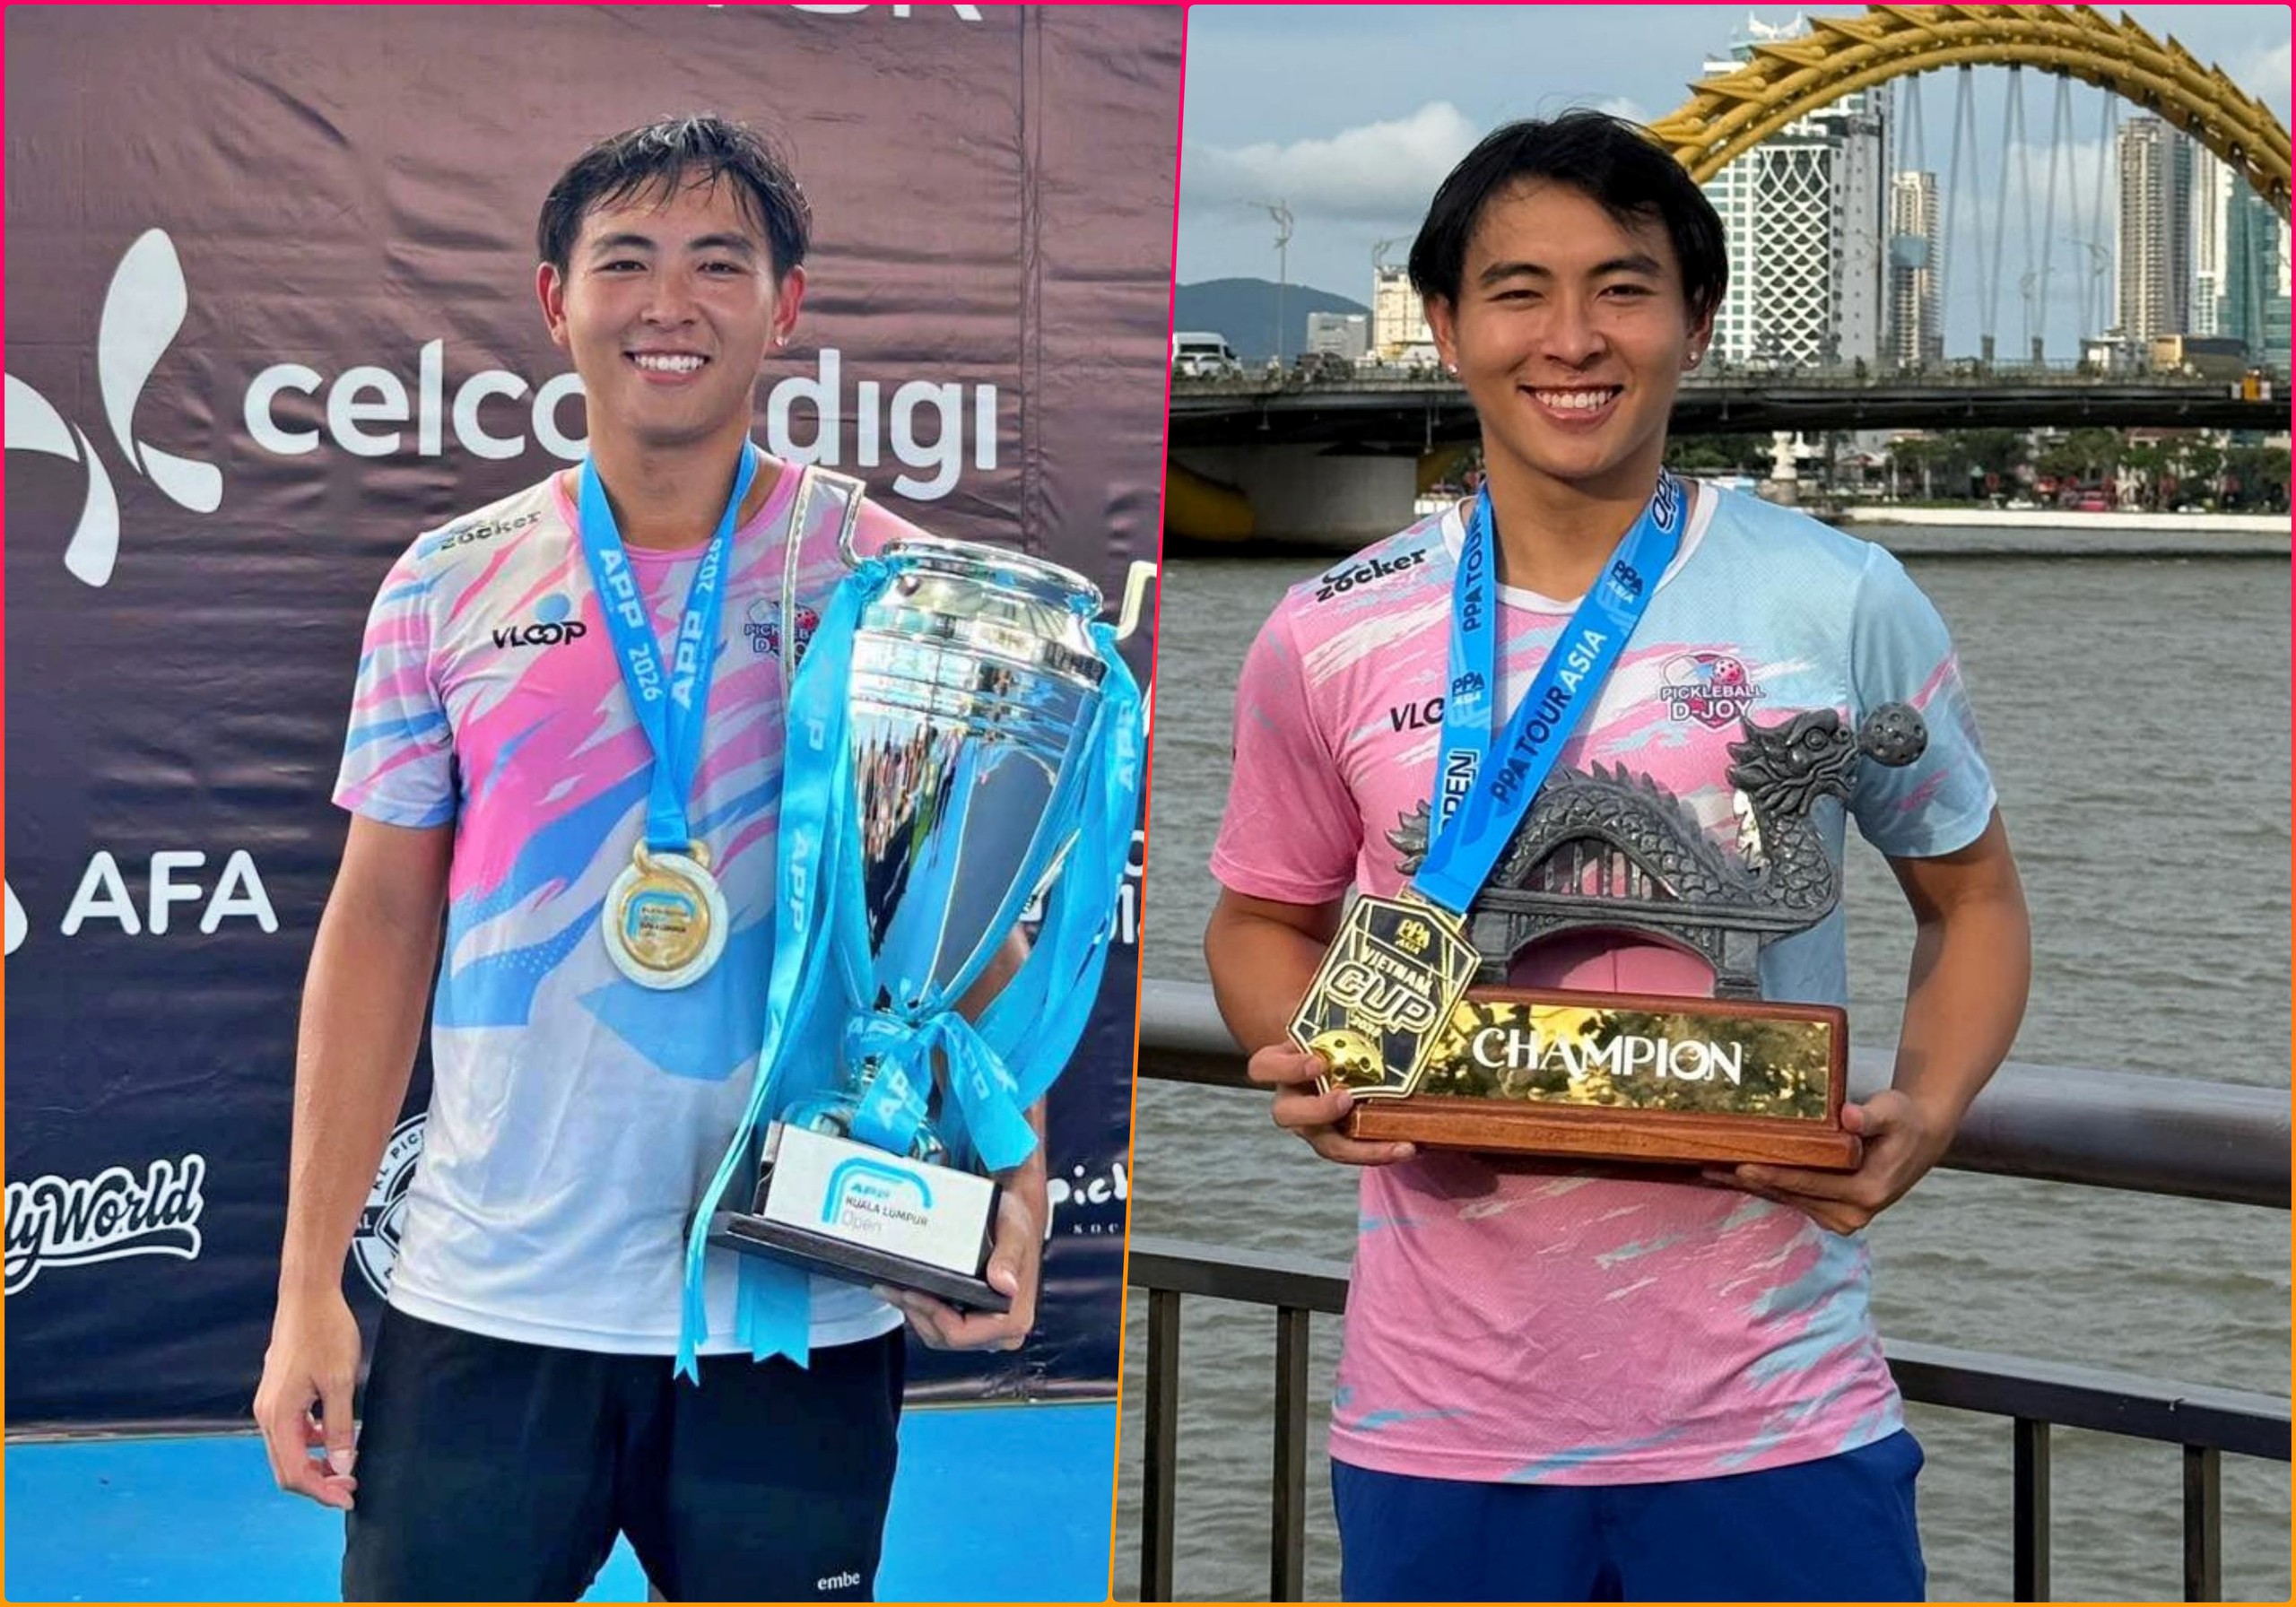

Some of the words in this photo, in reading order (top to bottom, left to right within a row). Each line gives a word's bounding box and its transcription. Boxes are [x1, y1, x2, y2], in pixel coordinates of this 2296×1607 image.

[1315, 548, 1427, 603] zocker
[1611, 559, 1644, 598] PPA
[492, 621, 587, 649] VLOOP
[598, 549, 645, 628] APP
[629, 643, 665, 701] 2026
[672, 610, 703, 709] APP
[1451, 672, 1486, 698] PPA
[1489, 758, 1530, 804] PPA
[1516, 685, 1573, 758] TOUR
[1559, 628, 1608, 693] ASIA
[1660, 683, 1764, 701] PICKLEBALL
[1671, 699, 1752, 720] D-JOY
[59, 848, 280, 936] AFA
[1326, 960, 1437, 1034] CUP
[1360, 942, 1433, 999] VIETNAM
[1472, 1026, 1743, 1086] CHAMPION
[817, 1571, 861, 1591] embe
